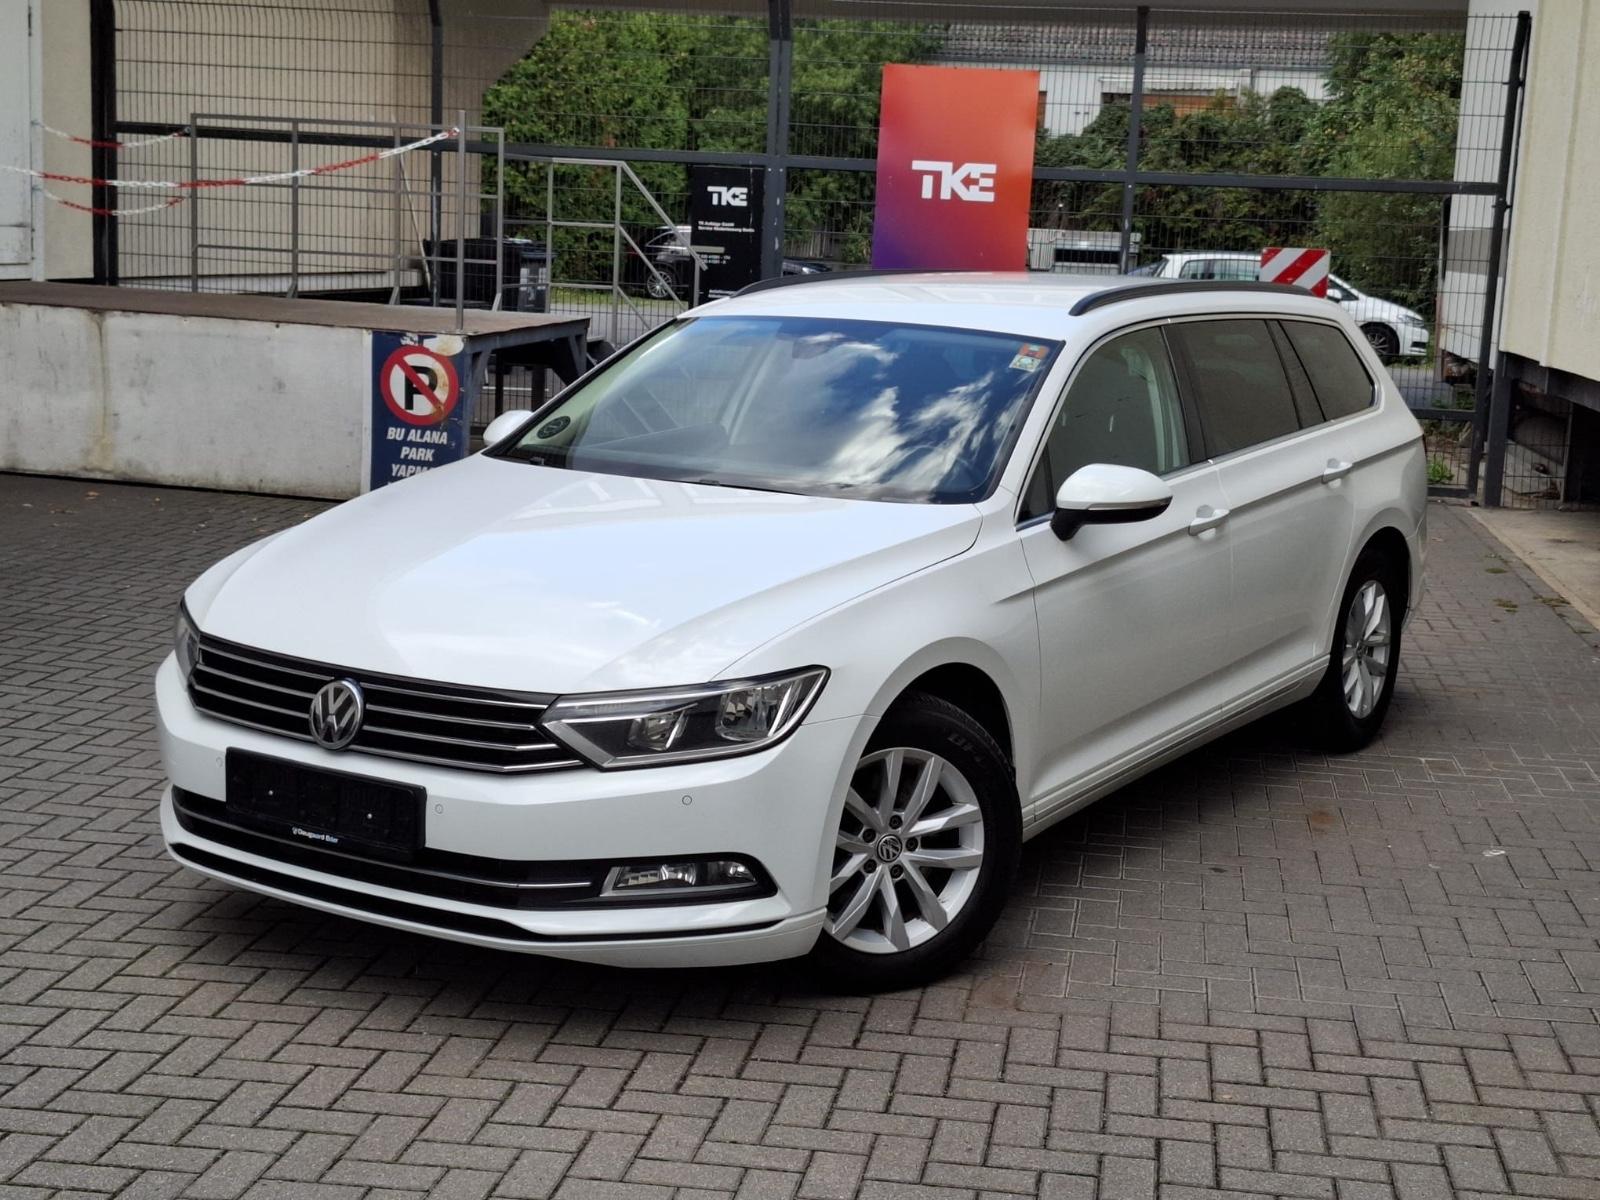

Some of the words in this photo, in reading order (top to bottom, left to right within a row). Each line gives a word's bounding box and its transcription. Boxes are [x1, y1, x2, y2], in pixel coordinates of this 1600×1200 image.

[911, 160, 997, 203] TKE
[707, 186, 748, 207] TKE
[387, 427, 406, 441] BU
[407, 429, 449, 445] ALANA
[400, 446, 435, 462] PARK
